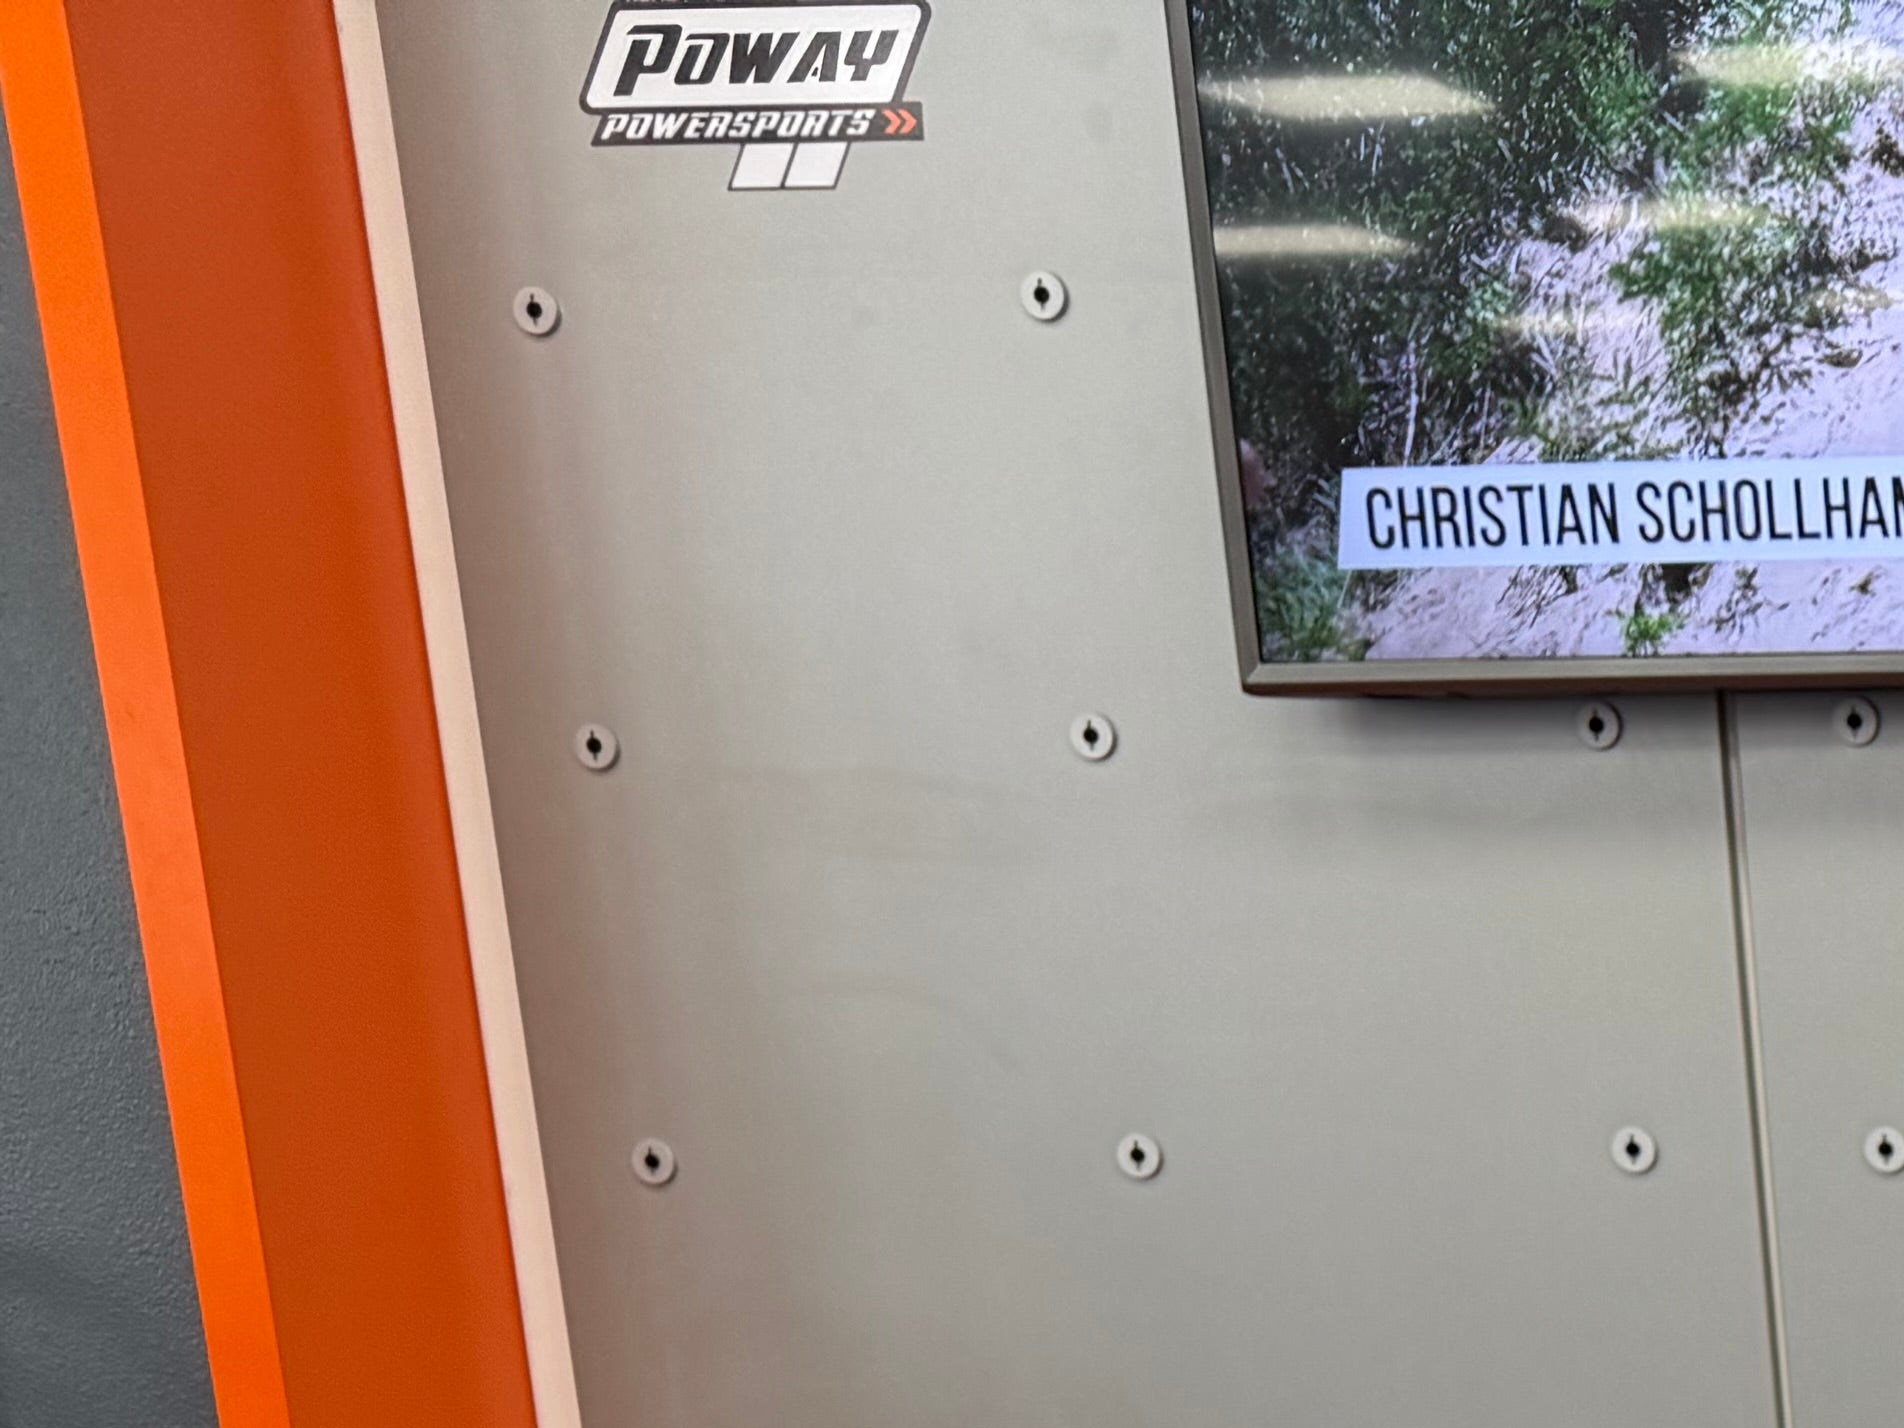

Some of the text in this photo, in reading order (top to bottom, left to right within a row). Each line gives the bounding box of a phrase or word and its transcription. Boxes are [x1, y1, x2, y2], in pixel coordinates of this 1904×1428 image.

[612, 24, 900, 97] POWAY
[601, 109, 877, 141] POWERSPORTS
[1365, 483, 1620, 549] CHRISTIAN
